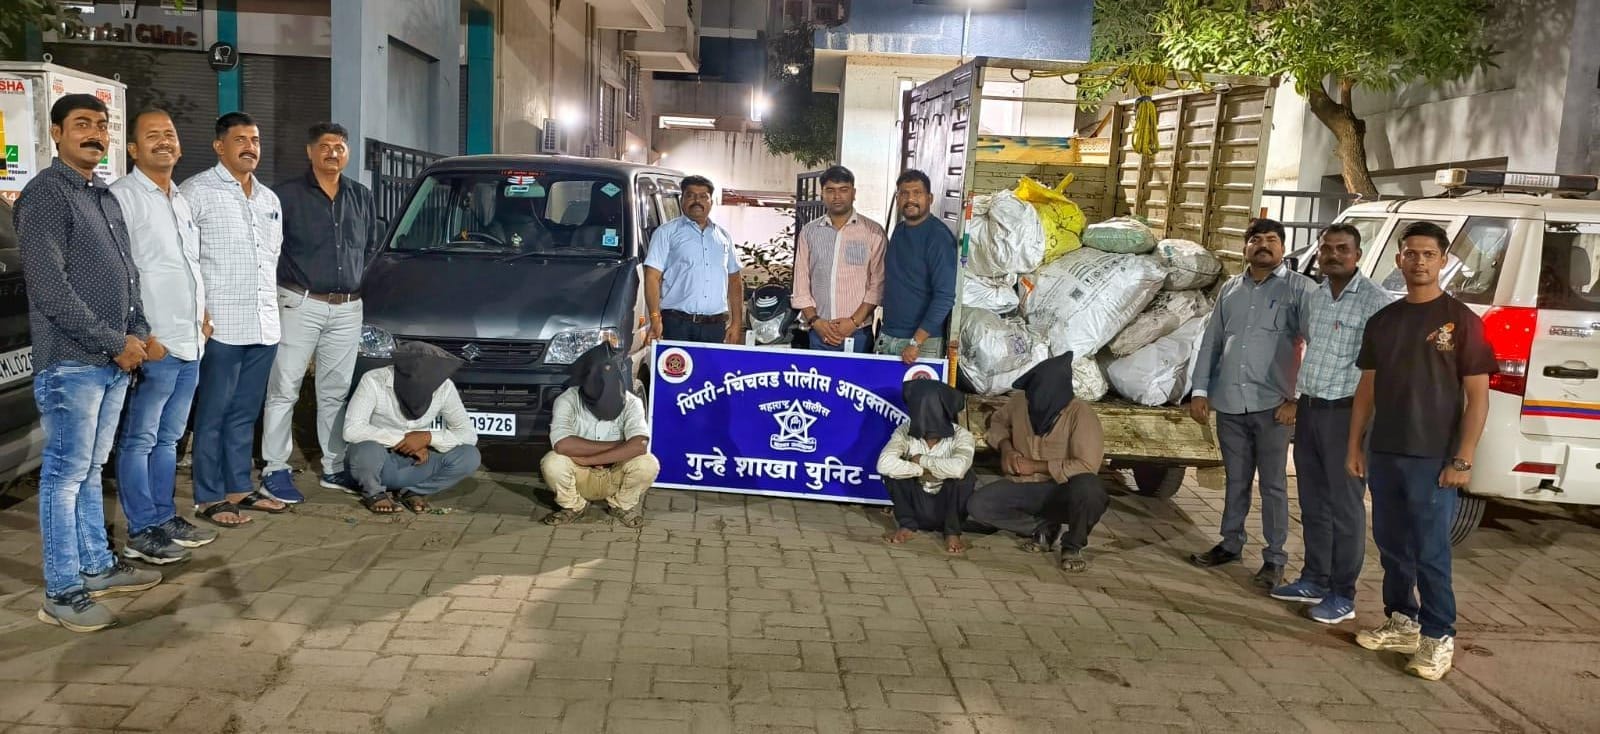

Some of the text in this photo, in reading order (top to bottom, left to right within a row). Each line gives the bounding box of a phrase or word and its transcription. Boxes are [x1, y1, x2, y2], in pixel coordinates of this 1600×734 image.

[135, 23, 198, 46] Clinic
[676, 369, 780, 415] पिंपरी-चिंचवड
[783, 364, 832, 393] पोलीस
[802, 399, 831, 417] पोलीस
[686, 447, 727, 481] गुन्हे
[734, 456, 797, 480] शाखा
[804, 456, 863, 490] युनिट
